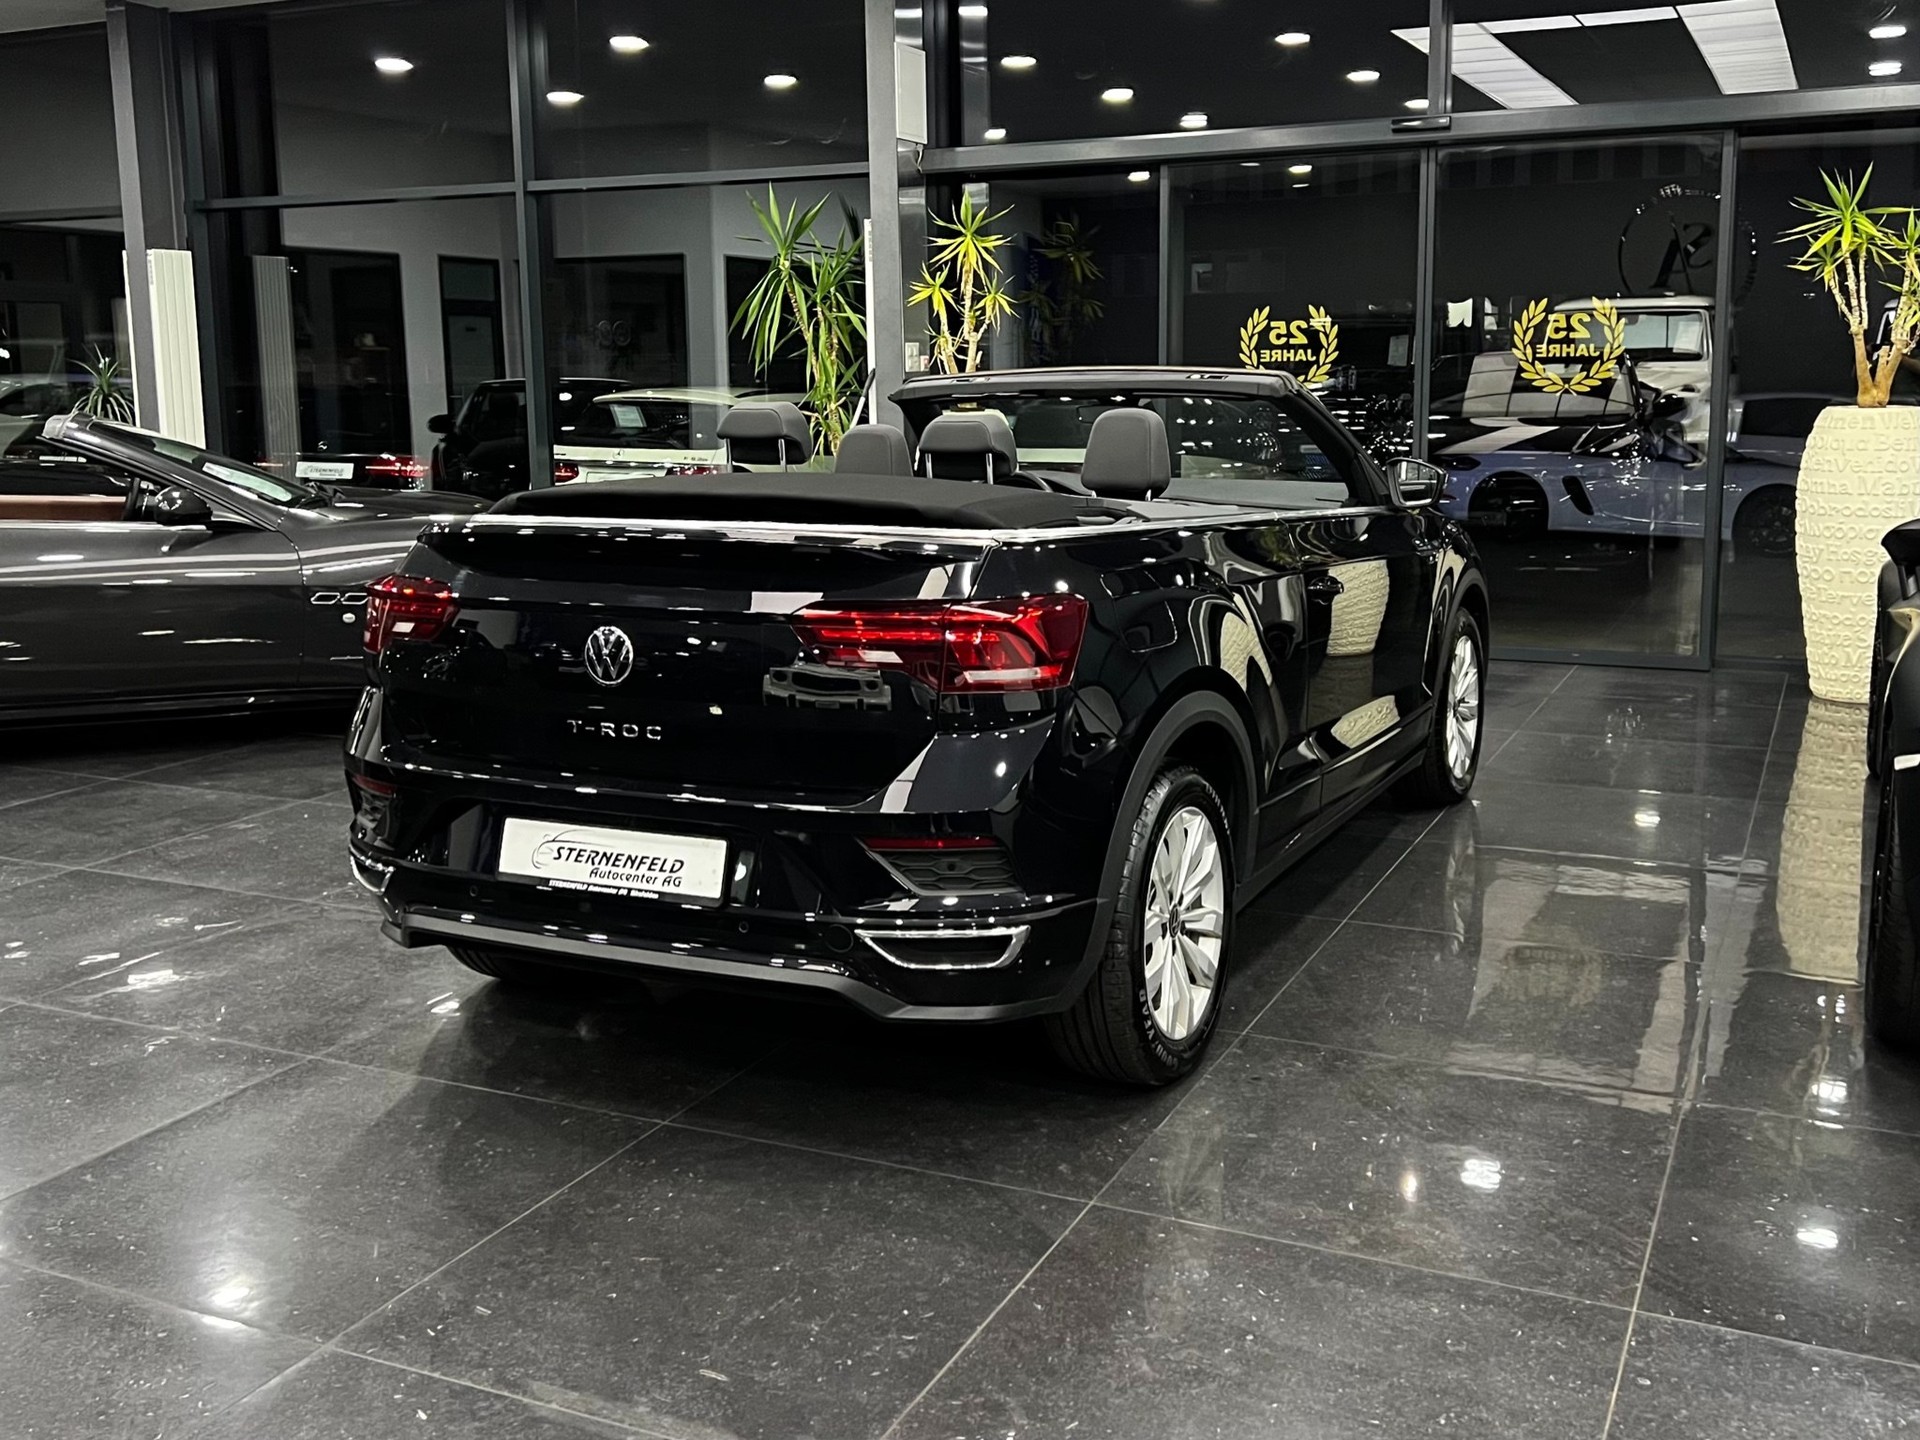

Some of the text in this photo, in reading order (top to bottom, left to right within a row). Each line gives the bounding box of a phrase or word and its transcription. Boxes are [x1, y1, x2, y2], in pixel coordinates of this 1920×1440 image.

[566, 719, 662, 741] T-ROC
[552, 846, 685, 874] STERNENFELD
[589, 867, 683, 888] Autocenter AG
